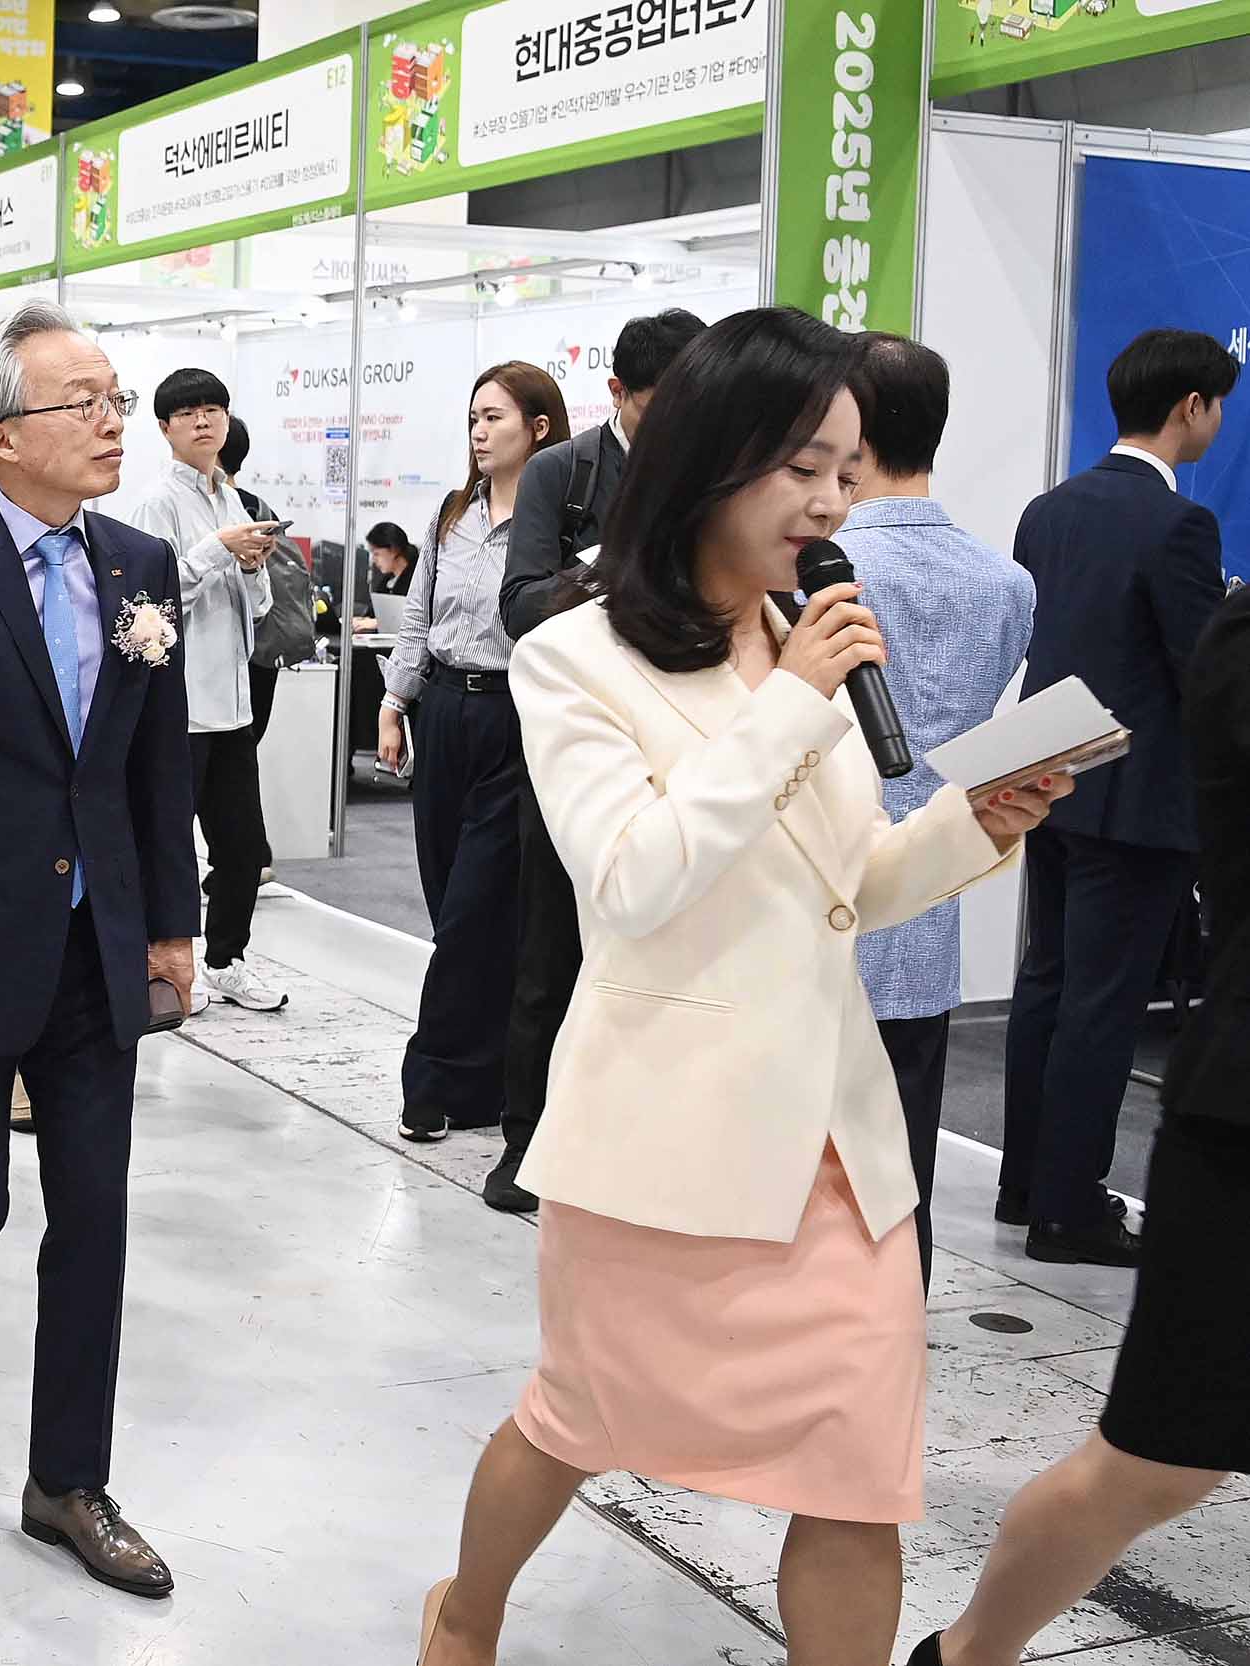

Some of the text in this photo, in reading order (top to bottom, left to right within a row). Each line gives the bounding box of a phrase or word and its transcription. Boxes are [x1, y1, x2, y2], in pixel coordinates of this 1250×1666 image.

[327, 65, 347, 89] E12
[624, 75, 670, 100] 우수기관
[673, 69, 697, 92] 인증
[700, 61, 724, 84] 기업
[825, 10, 876, 222] 2025년
[164, 109, 289, 178] 덕산에테르씨티
[1227, 326, 1250, 365] 세
[303, 368, 351, 389] DUKSA
[363, 361, 414, 385] GROUP
